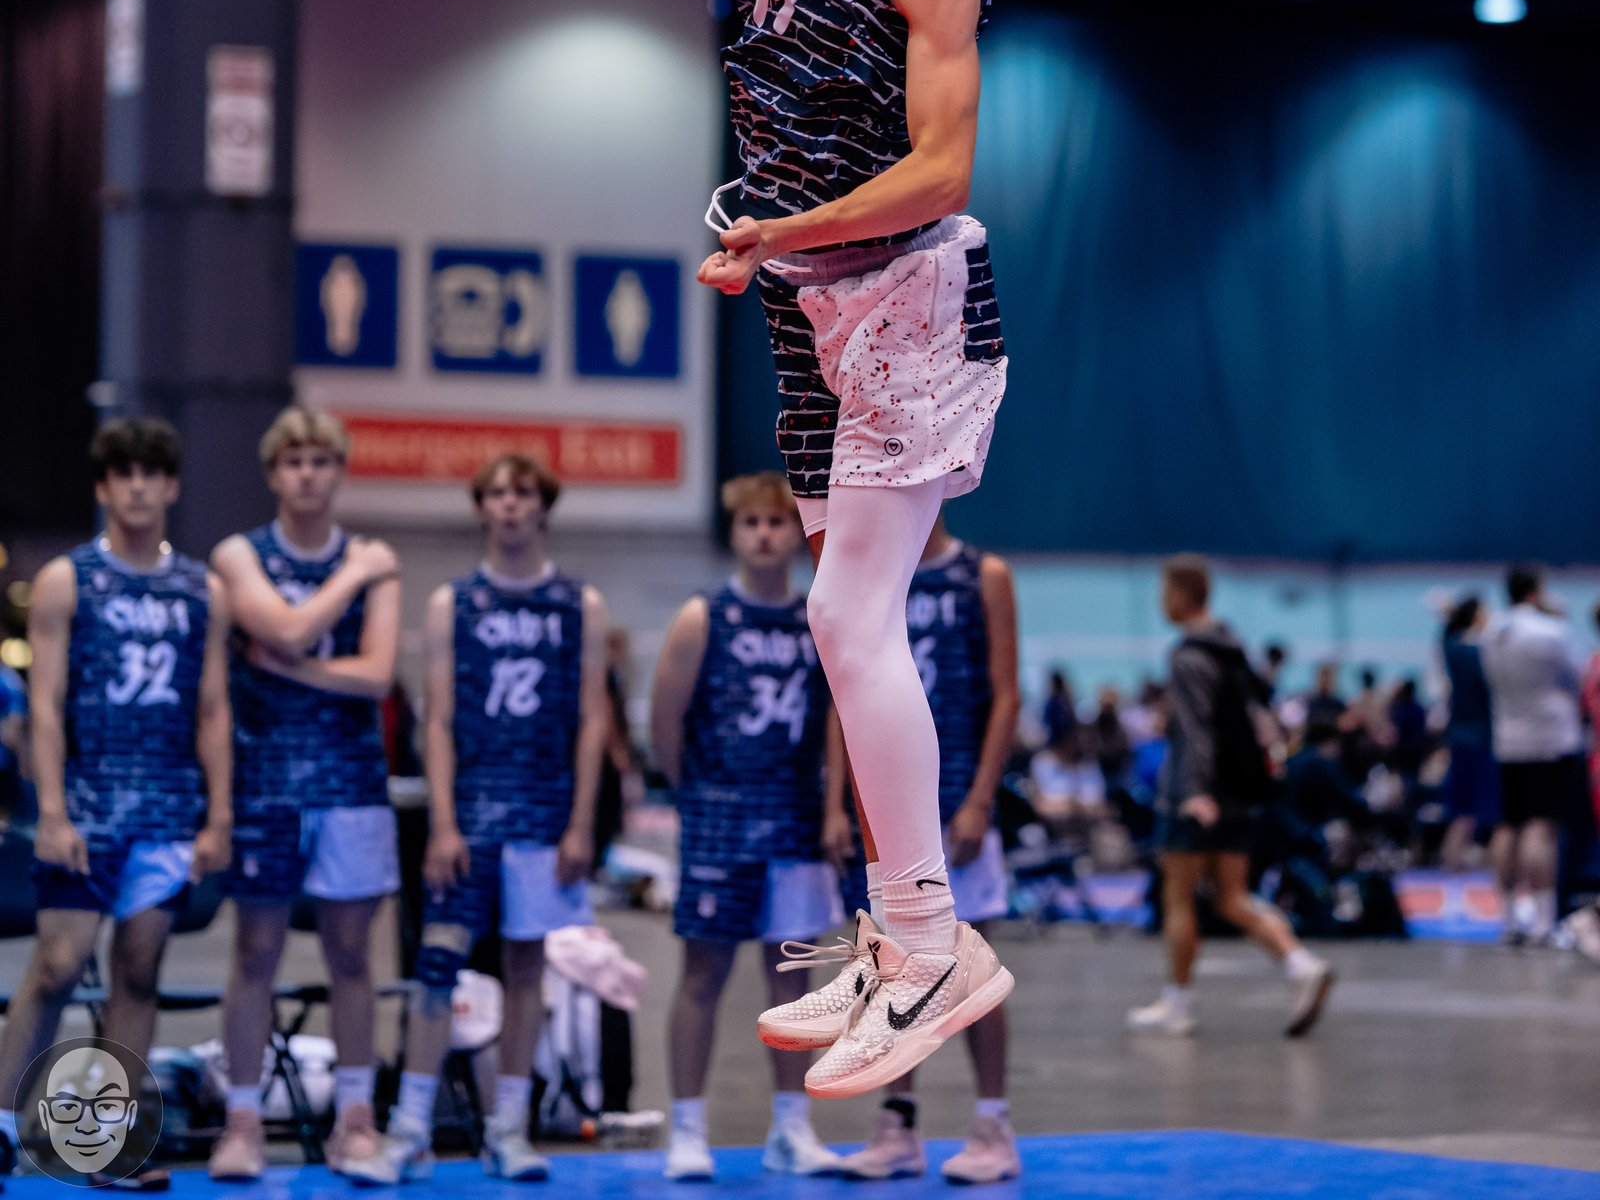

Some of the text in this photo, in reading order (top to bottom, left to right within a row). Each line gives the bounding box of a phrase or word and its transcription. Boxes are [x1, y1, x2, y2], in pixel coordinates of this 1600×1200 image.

[105, 641, 180, 706] 32
[484, 657, 546, 718] 18
[737, 667, 808, 743] 34
